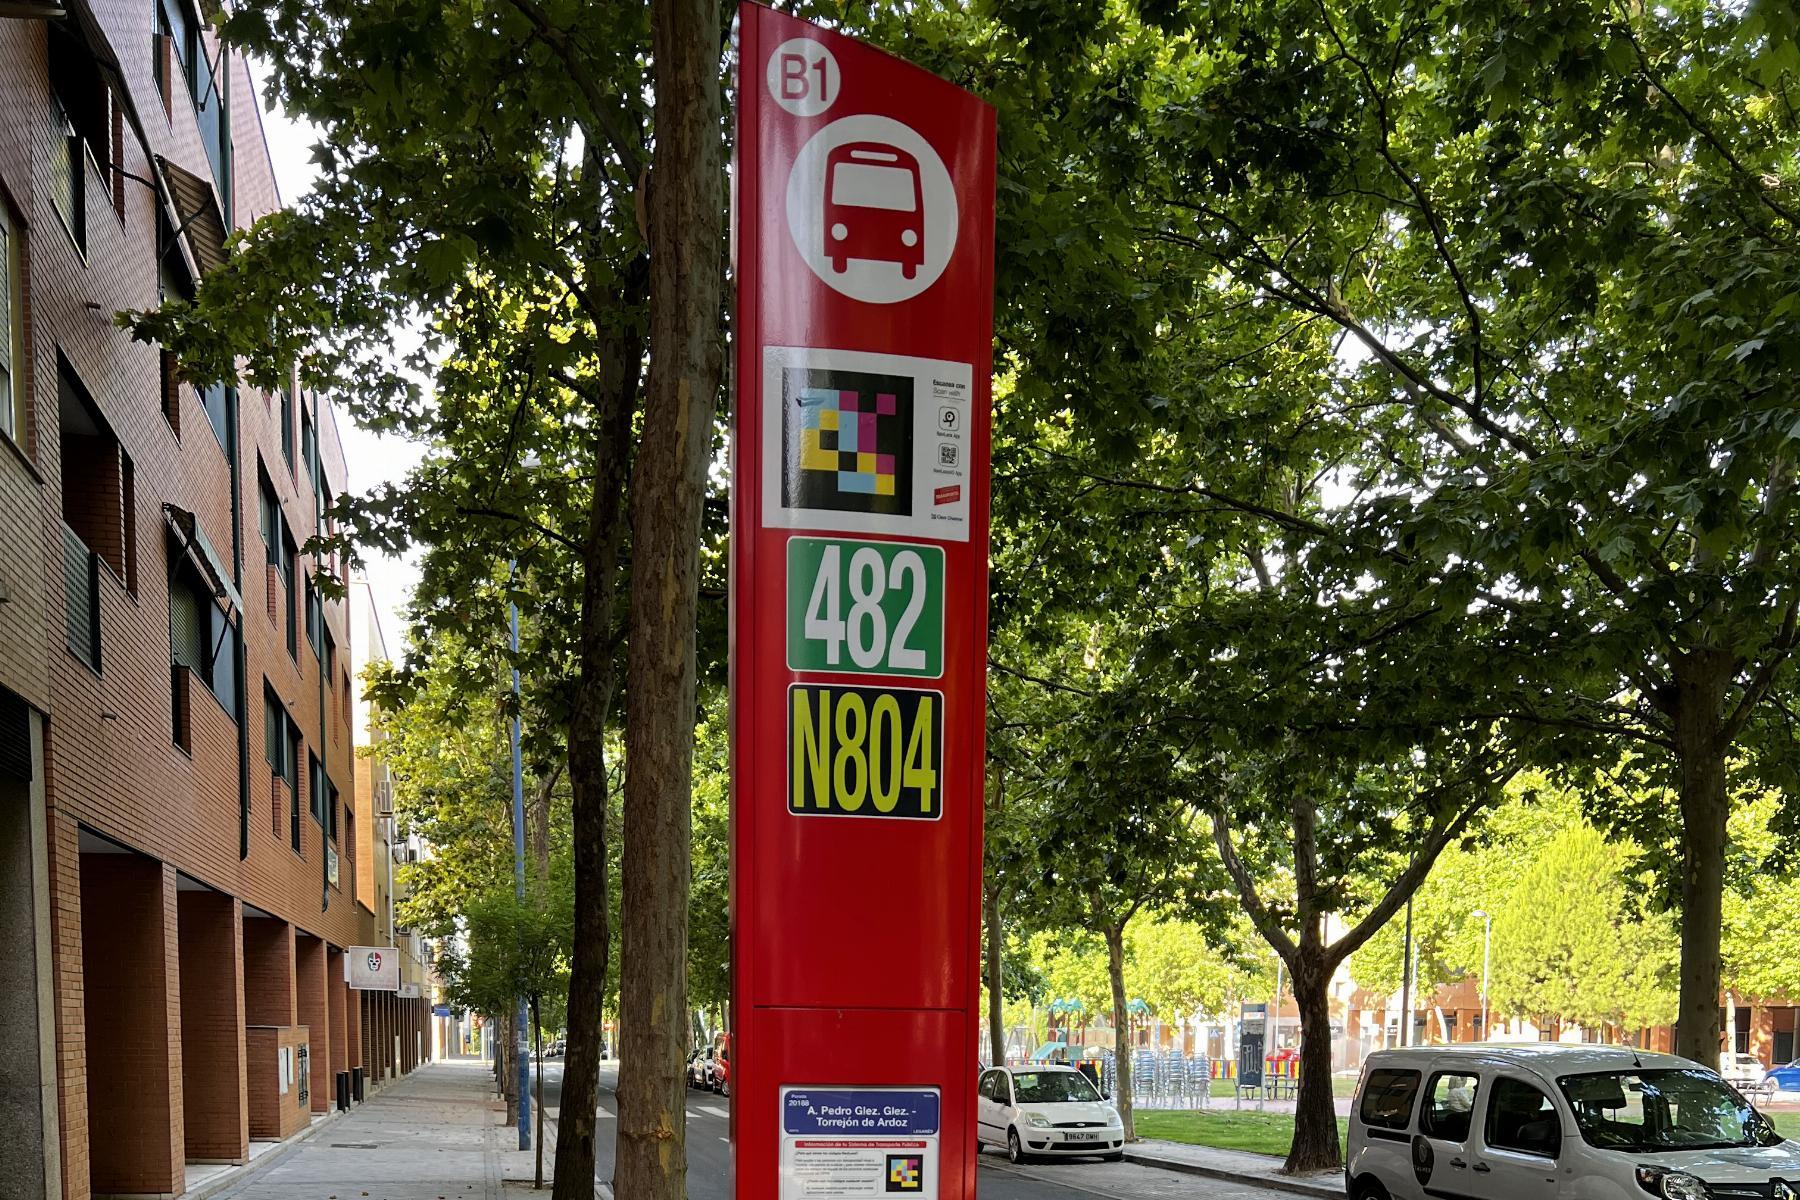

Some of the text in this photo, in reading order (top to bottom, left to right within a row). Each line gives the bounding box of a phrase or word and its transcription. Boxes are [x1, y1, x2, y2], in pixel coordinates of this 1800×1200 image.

[780, 53, 828, 102] B1
[804, 544, 927, 670] 482
[793, 688, 936, 813] N804
[807, 1106, 818, 1115] A.
[821, 1106, 852, 1115] Pedro
[855, 1106, 880, 1116] Glez.
[883, 1106, 909, 1116] Glez.
[816, 1117, 908, 1129] Torrejón de Ardoz
